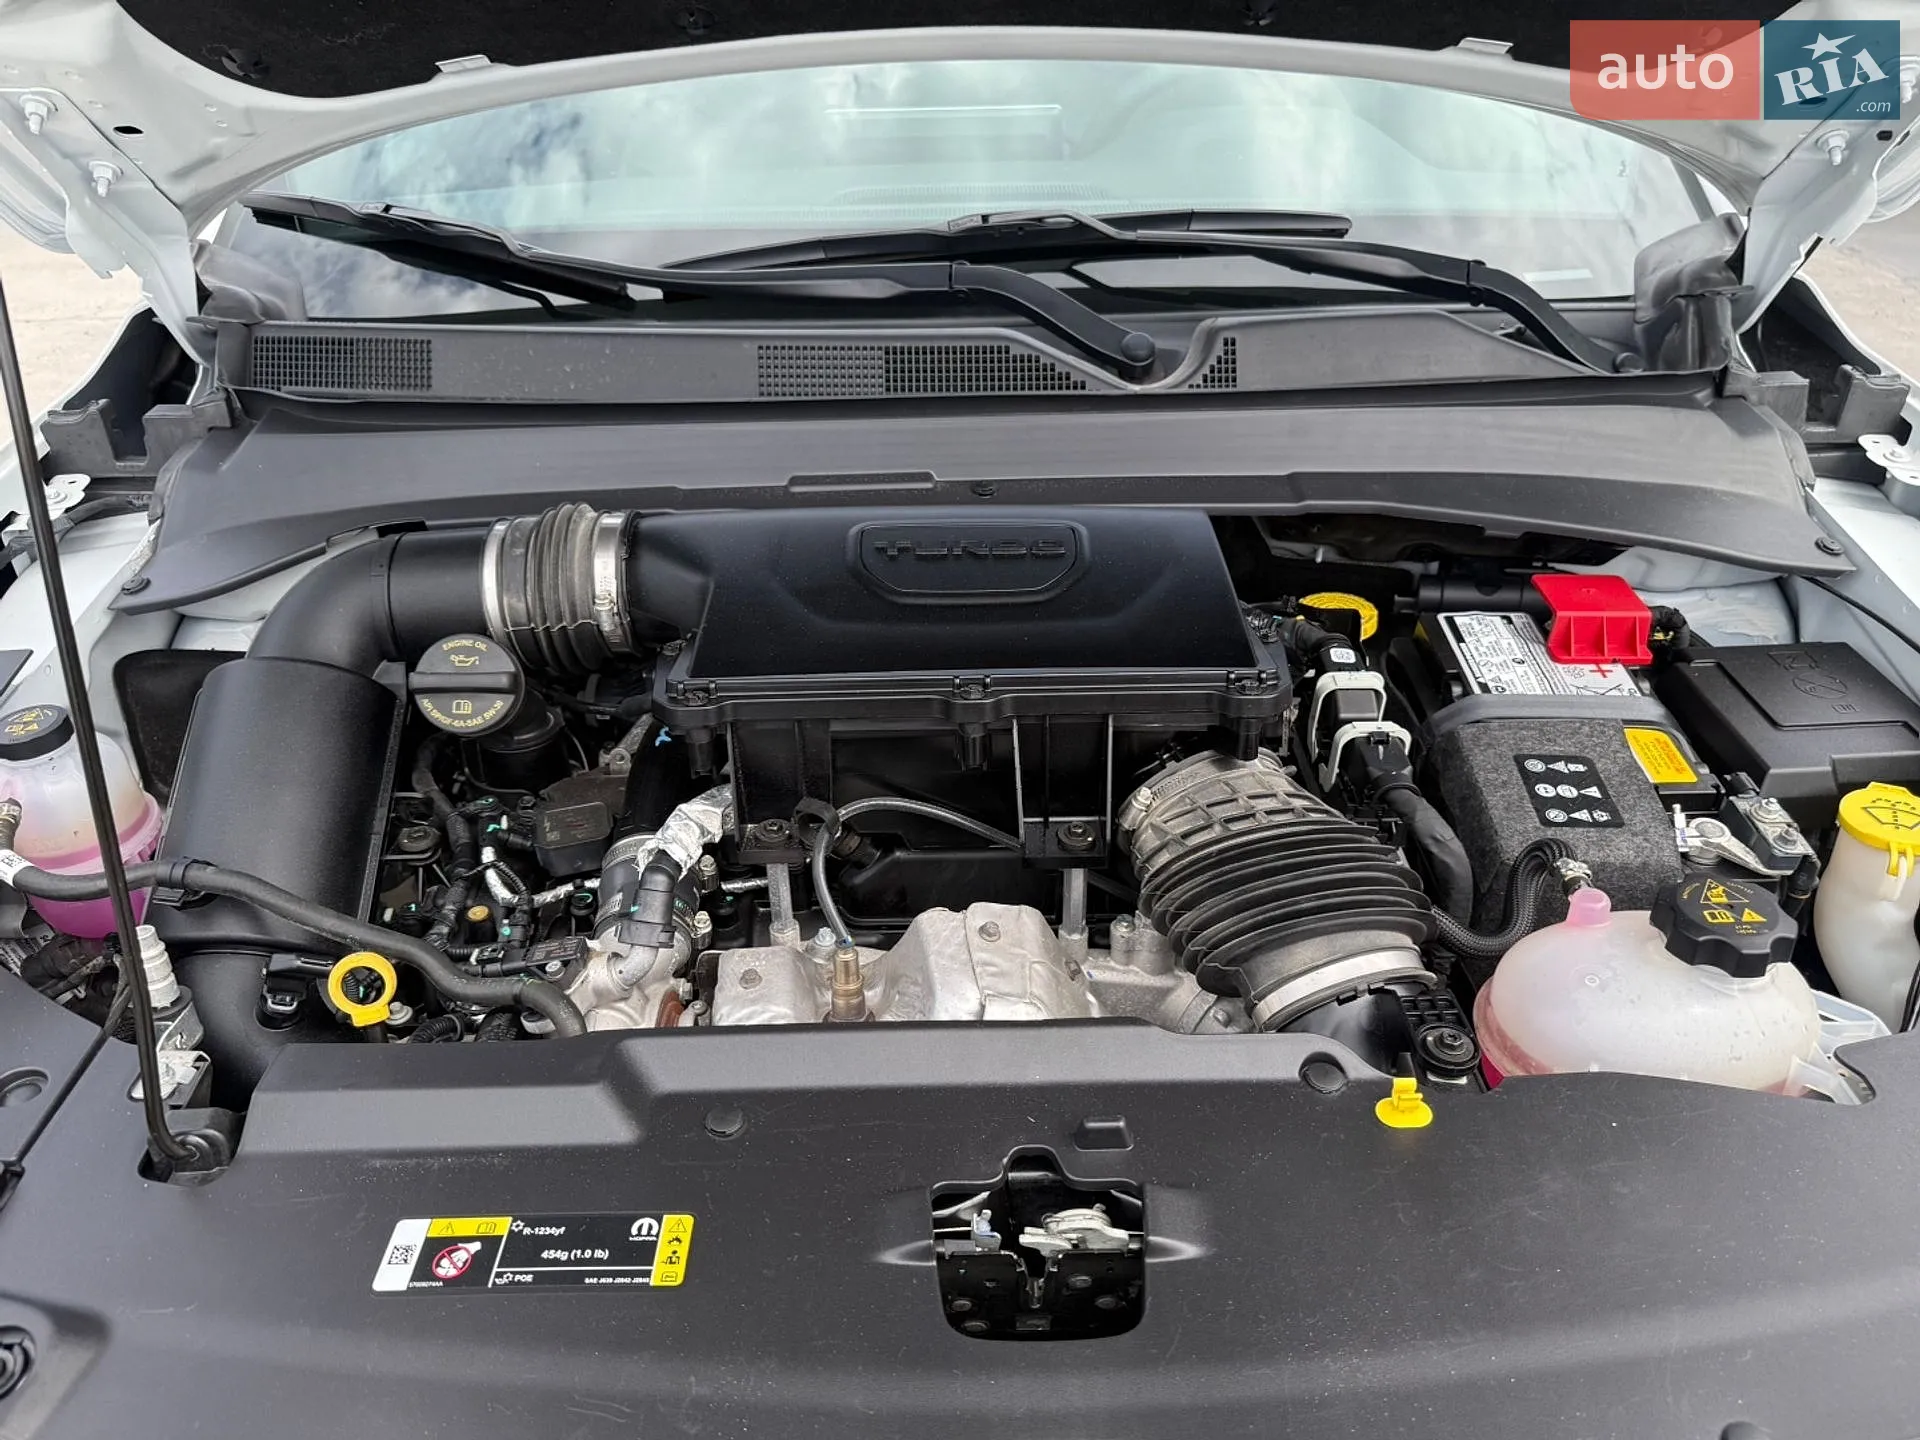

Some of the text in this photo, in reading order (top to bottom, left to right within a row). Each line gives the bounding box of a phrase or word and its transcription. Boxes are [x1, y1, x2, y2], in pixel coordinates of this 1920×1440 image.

[442, 639, 488, 652] ENGINE OIL
[522, 1226, 566, 1236] R-1234yf
[540, 1248, 609, 1261] 454g (1.0 lb)
